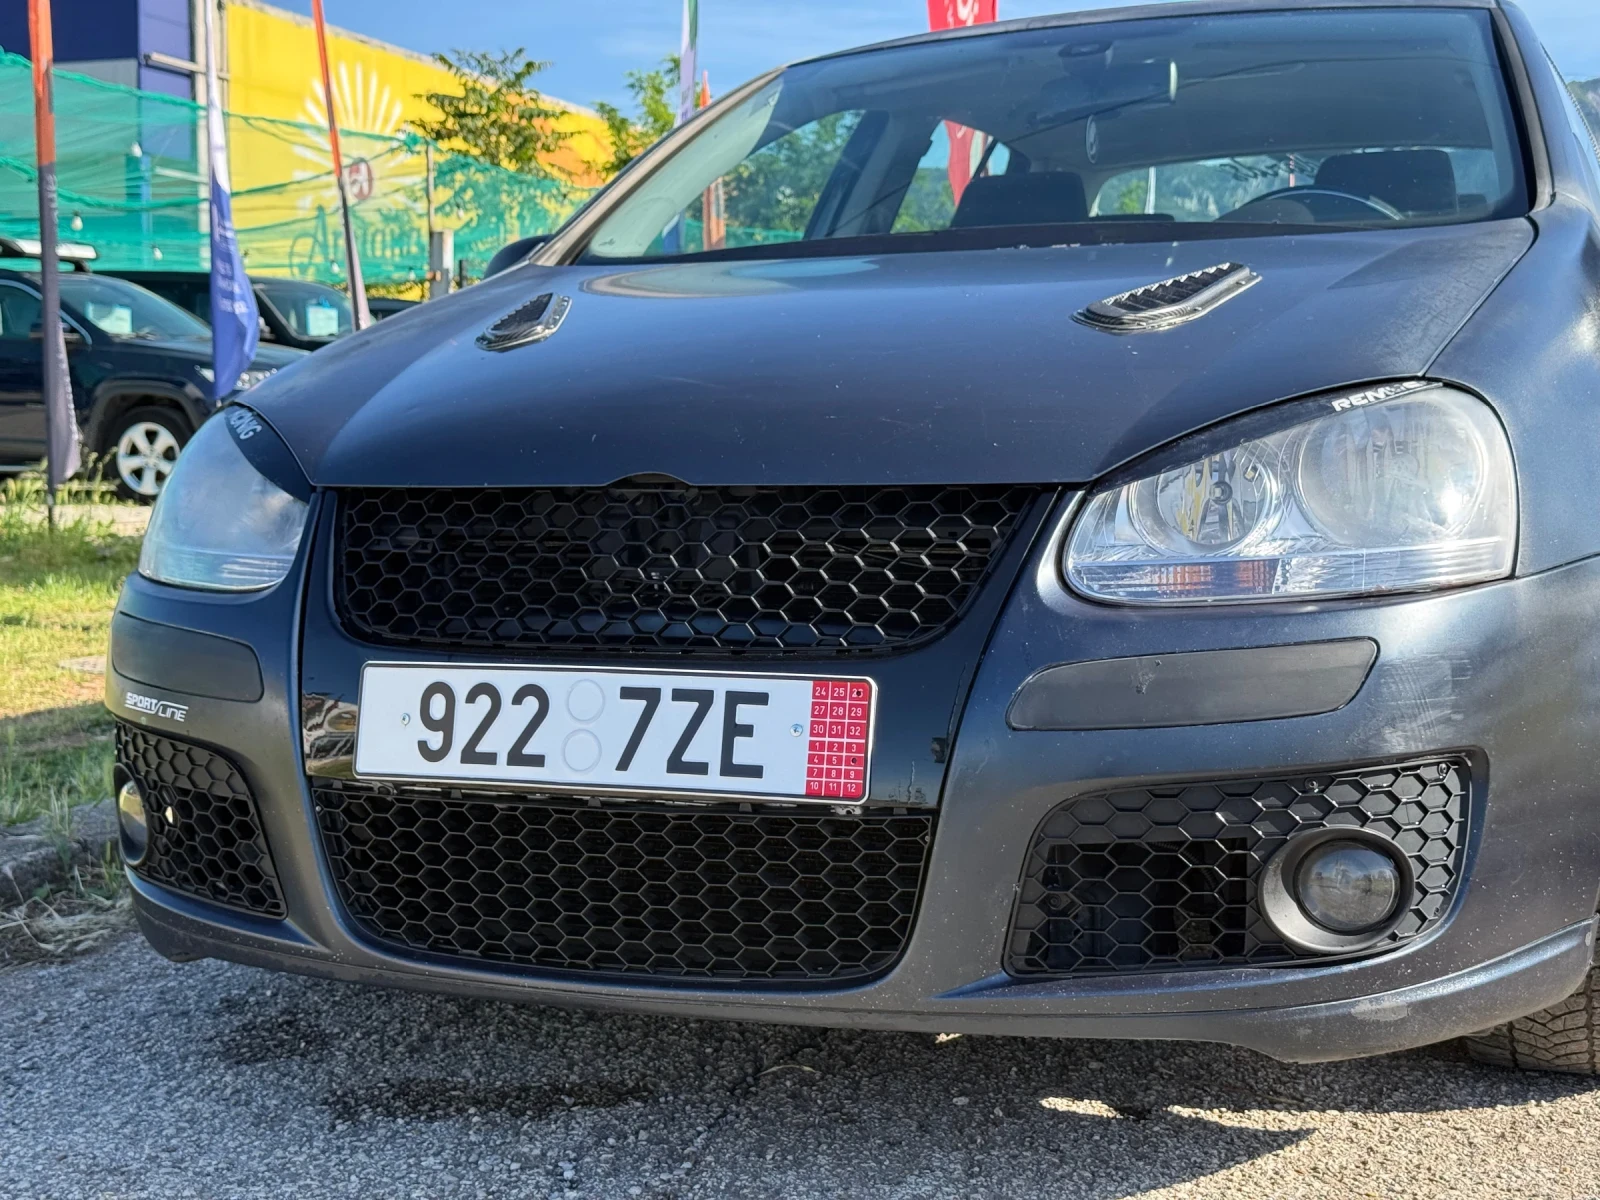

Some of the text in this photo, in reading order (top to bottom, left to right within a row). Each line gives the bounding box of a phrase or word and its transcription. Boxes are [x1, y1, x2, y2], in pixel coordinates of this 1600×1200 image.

[815, 687, 826, 697] 24
[833, 688, 845, 697] 25
[125, 692, 158, 711] SPORT
[814, 706, 862, 717] 27 28 29
[417, 681, 770, 778] 922 7ZE
[812, 725, 861, 736] 30 31 32
[833, 743, 838, 751] 2
[851, 744, 857, 752] 3
[813, 755, 837, 765] 4 5
[813, 768, 855, 779] 7 8 9
[810, 781, 856, 792] 10 11 12
